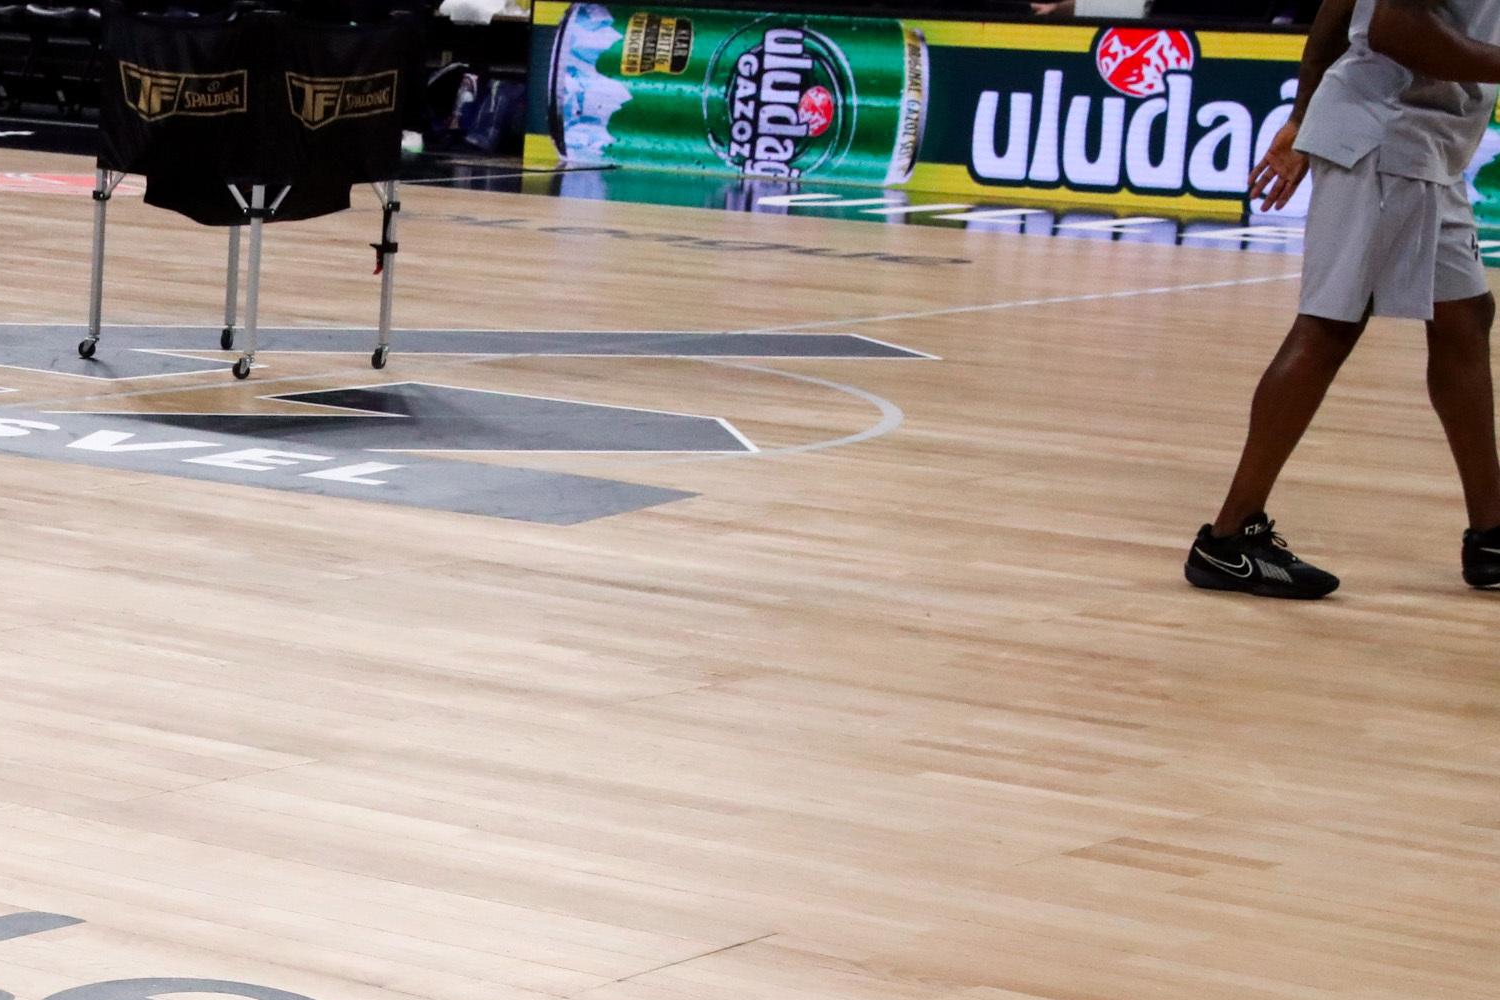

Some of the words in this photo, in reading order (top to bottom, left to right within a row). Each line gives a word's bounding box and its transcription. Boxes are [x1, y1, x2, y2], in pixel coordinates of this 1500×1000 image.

[125, 69, 179, 116] TF
[184, 88, 240, 110] SPALDING
[291, 78, 341, 122] TF
[345, 86, 391, 111] SPALDING
[730, 53, 759, 158] GAZOZ
